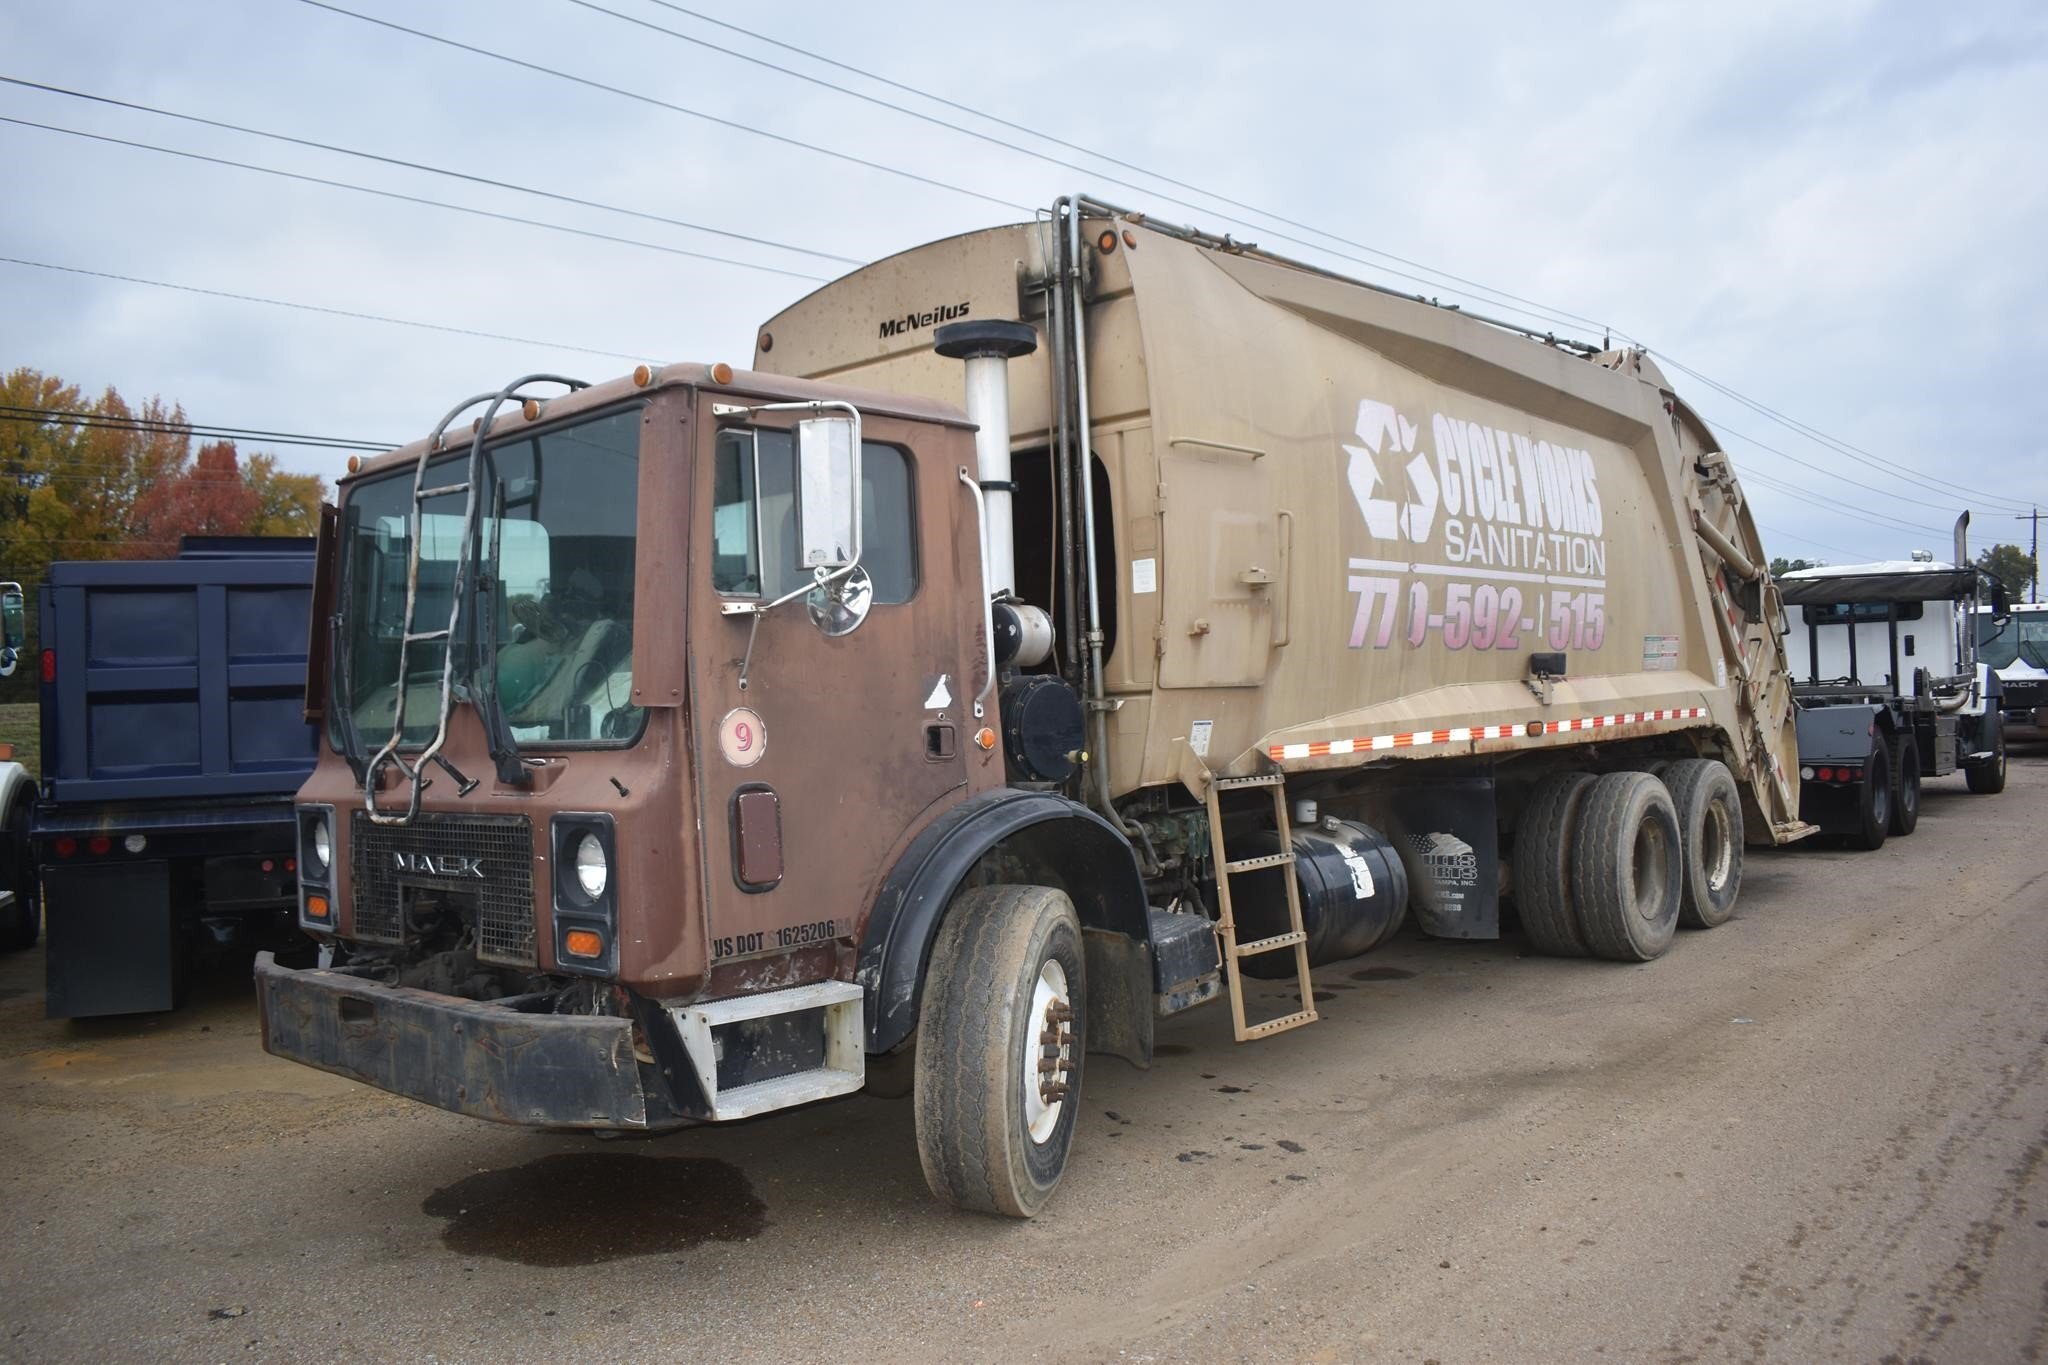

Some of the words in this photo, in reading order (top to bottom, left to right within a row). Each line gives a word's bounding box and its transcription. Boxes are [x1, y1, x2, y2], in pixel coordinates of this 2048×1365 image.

[879, 302, 970, 338] McNeilus
[1445, 519, 1605, 576] SANITATION
[735, 722, 752, 751] 9
[713, 937, 732, 957] US
[736, 932, 763, 953] DOT
[776, 920, 835, 946] 1625206
